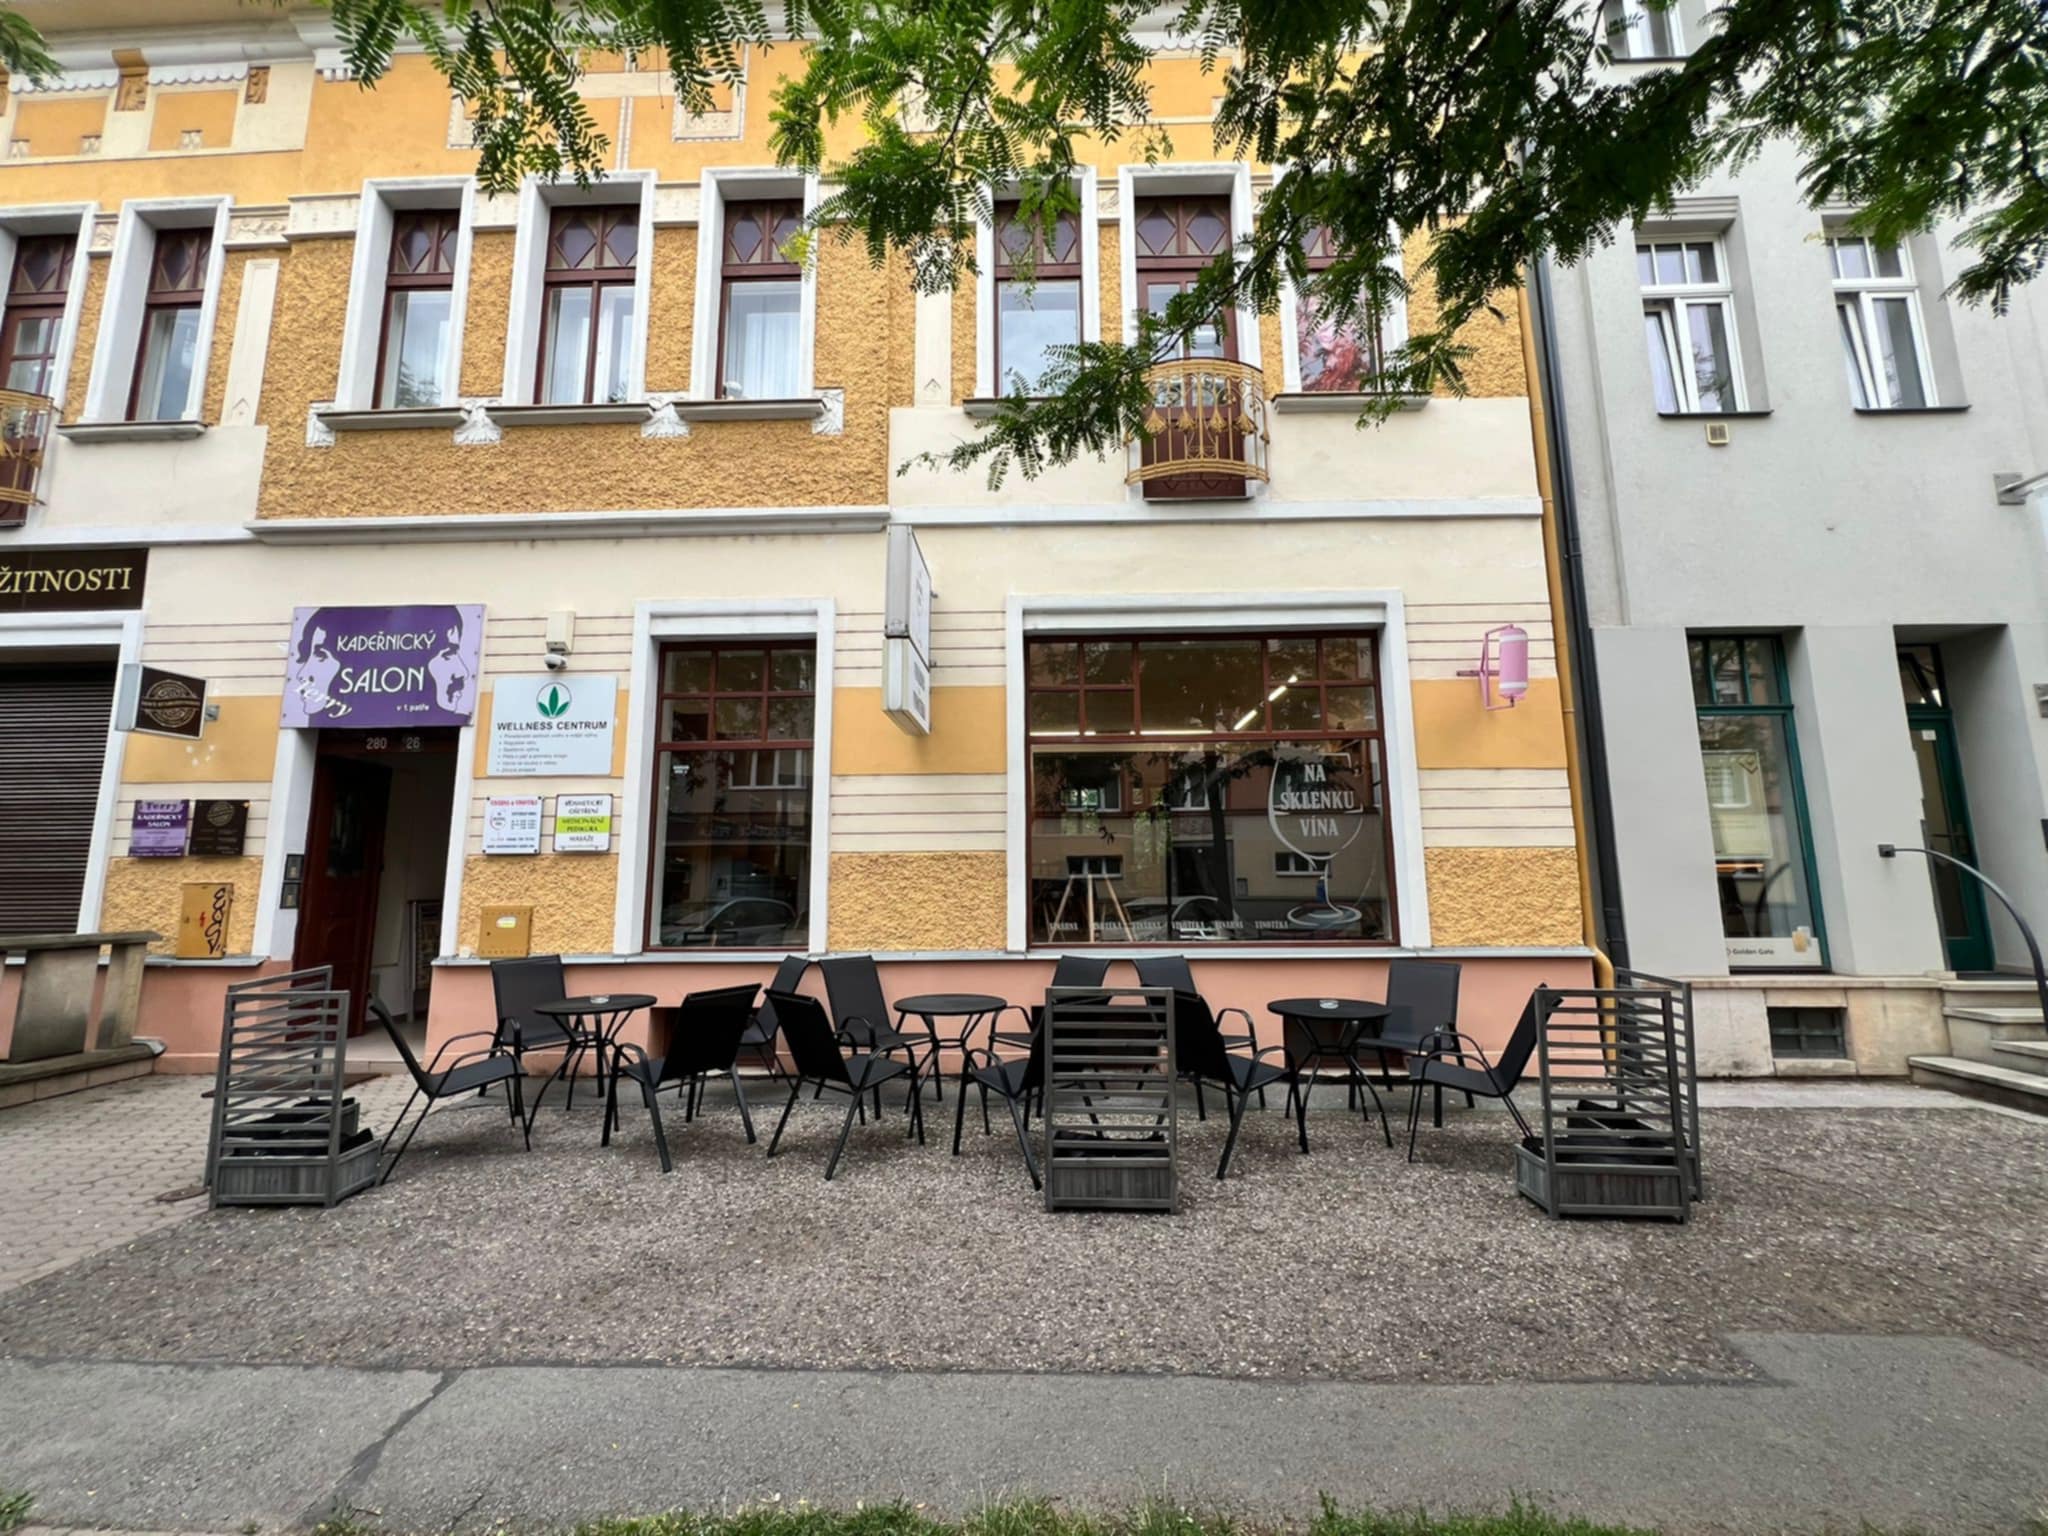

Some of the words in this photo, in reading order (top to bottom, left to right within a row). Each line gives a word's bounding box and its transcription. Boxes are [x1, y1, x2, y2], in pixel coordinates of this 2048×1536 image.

[0, 566, 132, 593] ŽITNOSTI
[336, 630, 436, 652] KADEŘNICKÝ
[339, 666, 425, 694] SALON
[497, 721, 553, 731] WELLNESS
[556, 720, 608, 730] CENTRUM
[366, 737, 388, 750] 280
[405, 736, 420, 749] 26
[1304, 764, 1326, 782] NA
[1280, 791, 1354, 810] SKLENKU
[1300, 815, 1339, 837] VÍNA
